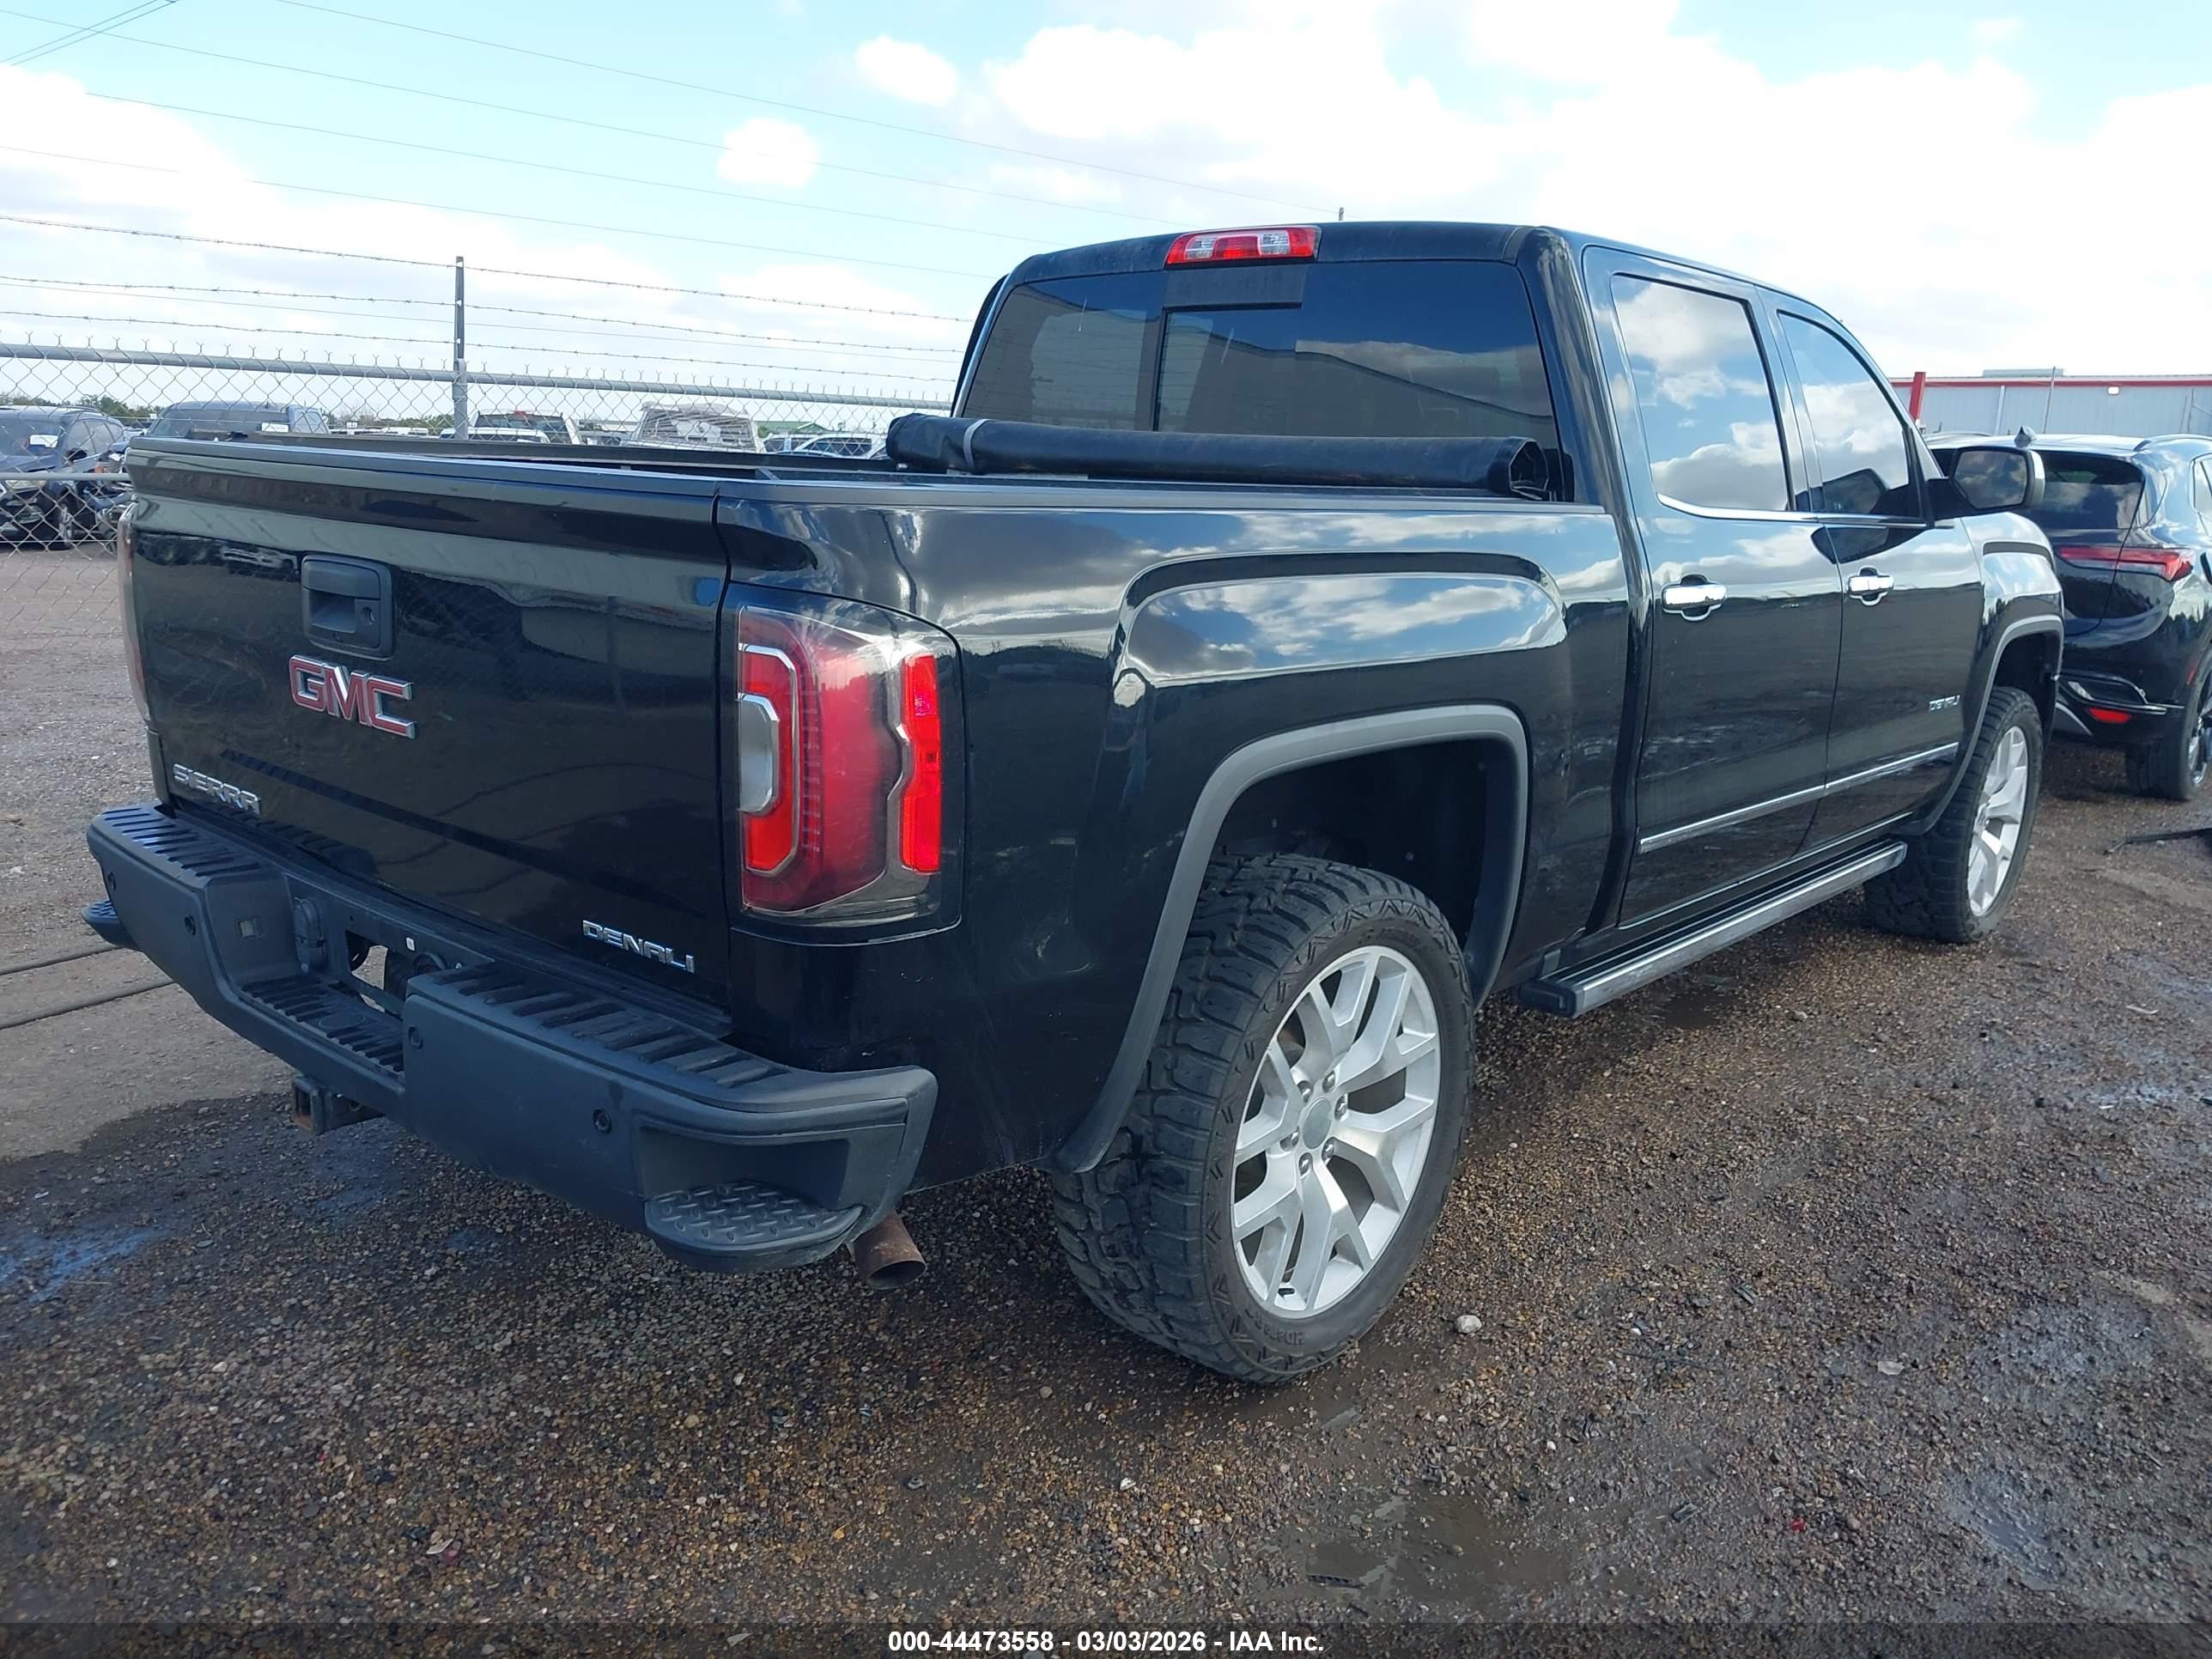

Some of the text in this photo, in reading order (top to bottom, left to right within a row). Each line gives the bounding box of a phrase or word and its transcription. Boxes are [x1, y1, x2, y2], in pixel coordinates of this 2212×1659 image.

[289, 654, 416, 739] GMC
[173, 763, 261, 815] SIERRA
[582, 920, 695, 974] DENALI
